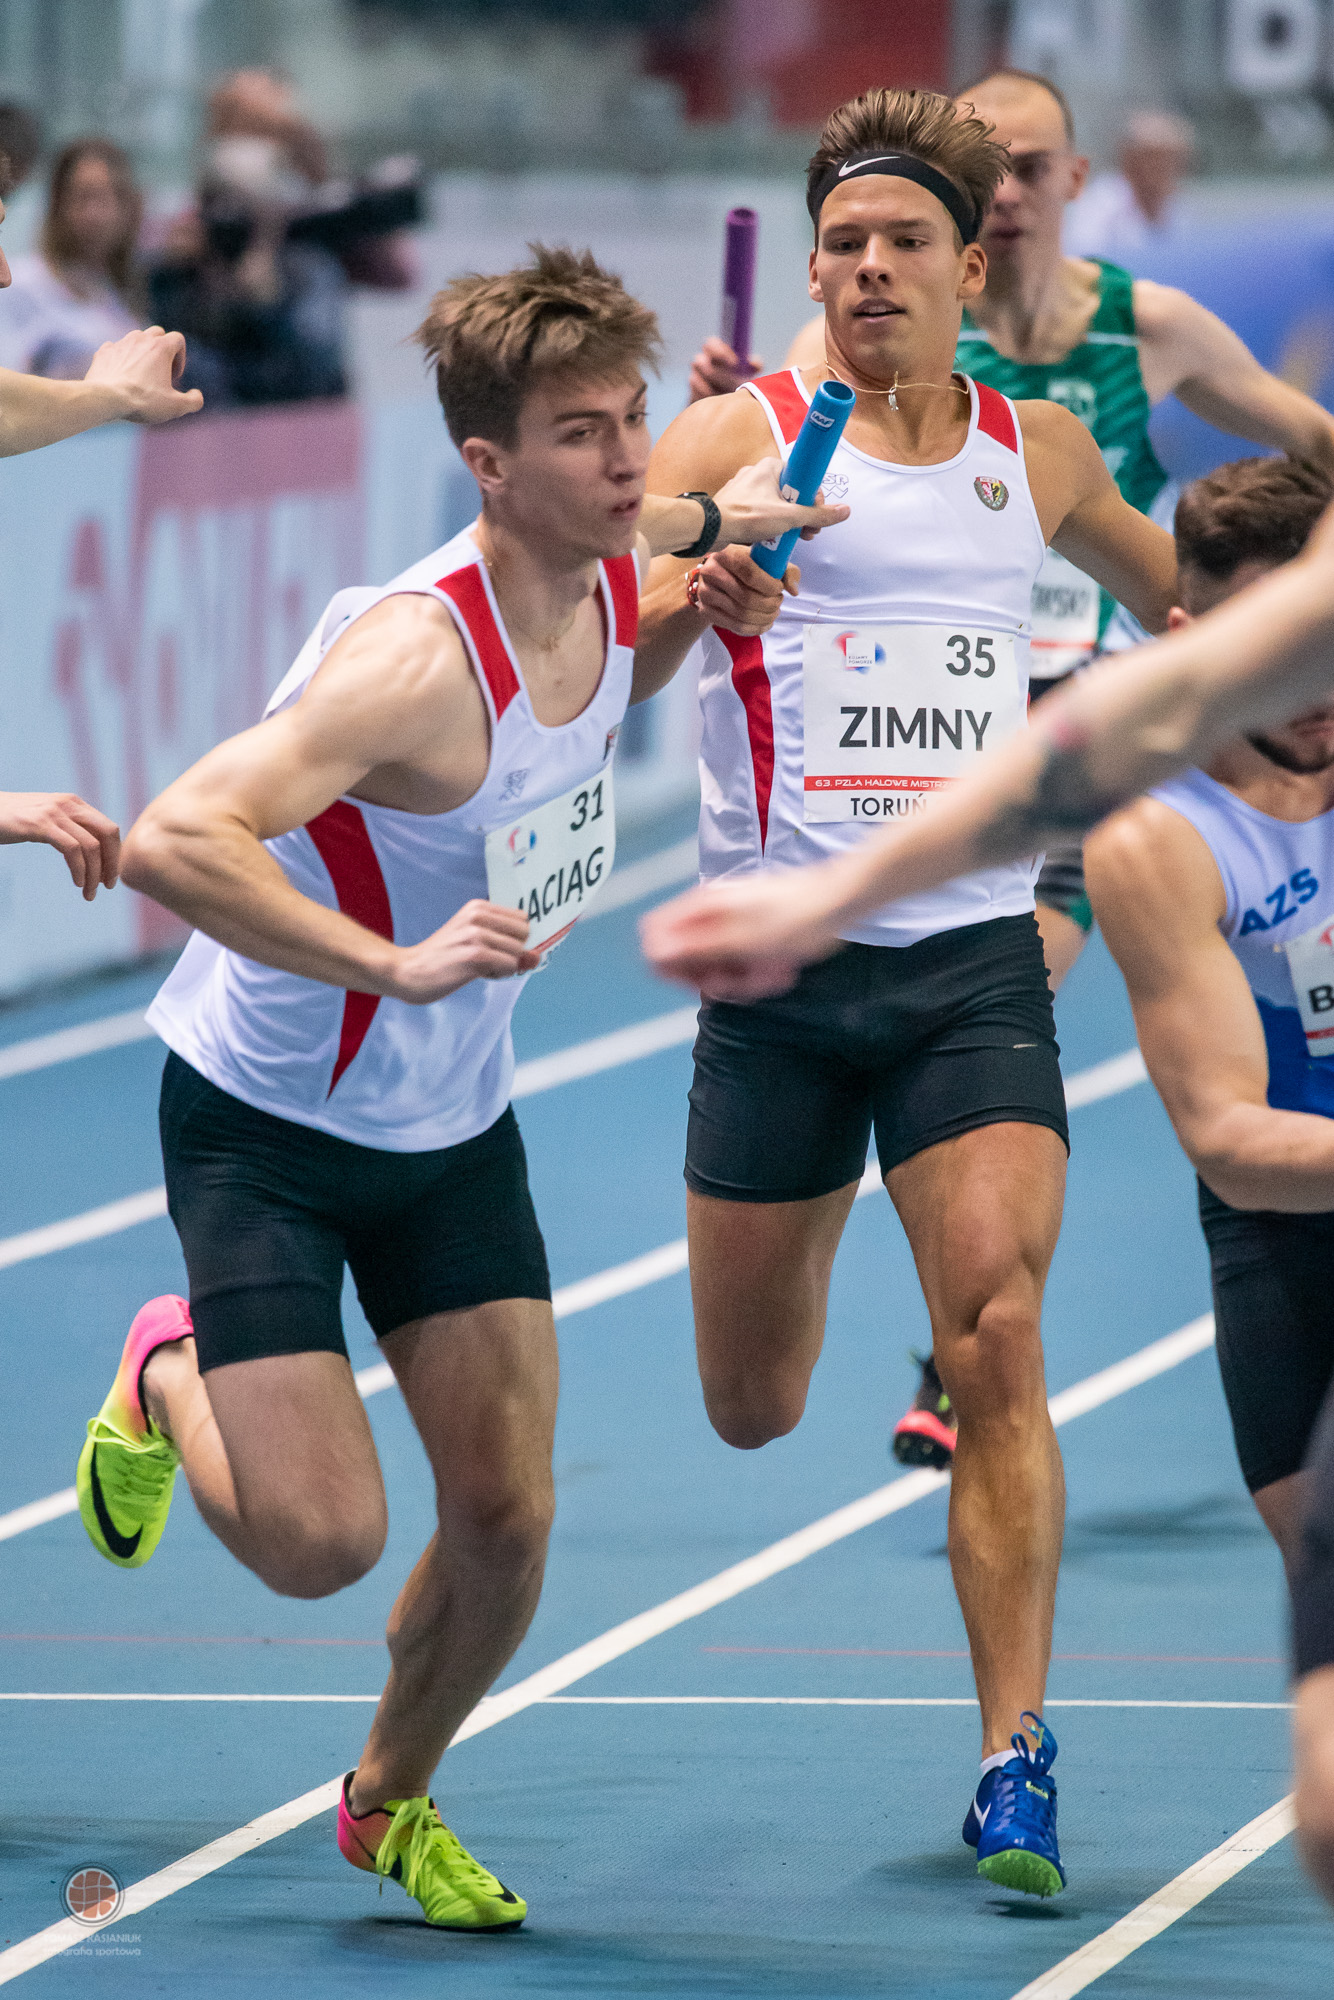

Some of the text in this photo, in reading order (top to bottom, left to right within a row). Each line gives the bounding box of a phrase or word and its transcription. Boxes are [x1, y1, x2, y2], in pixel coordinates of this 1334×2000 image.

[945, 634, 996, 678] 35
[839, 706, 992, 751] ZIMNY
[815, 779, 833, 787] 63.
[835, 779, 863, 787] PZLA
[864, 779, 908, 787] HALOWE
[850, 793, 927, 816] TORUŃ
[570, 780, 604, 831] 31
[1239, 868, 1318, 936] AZS
